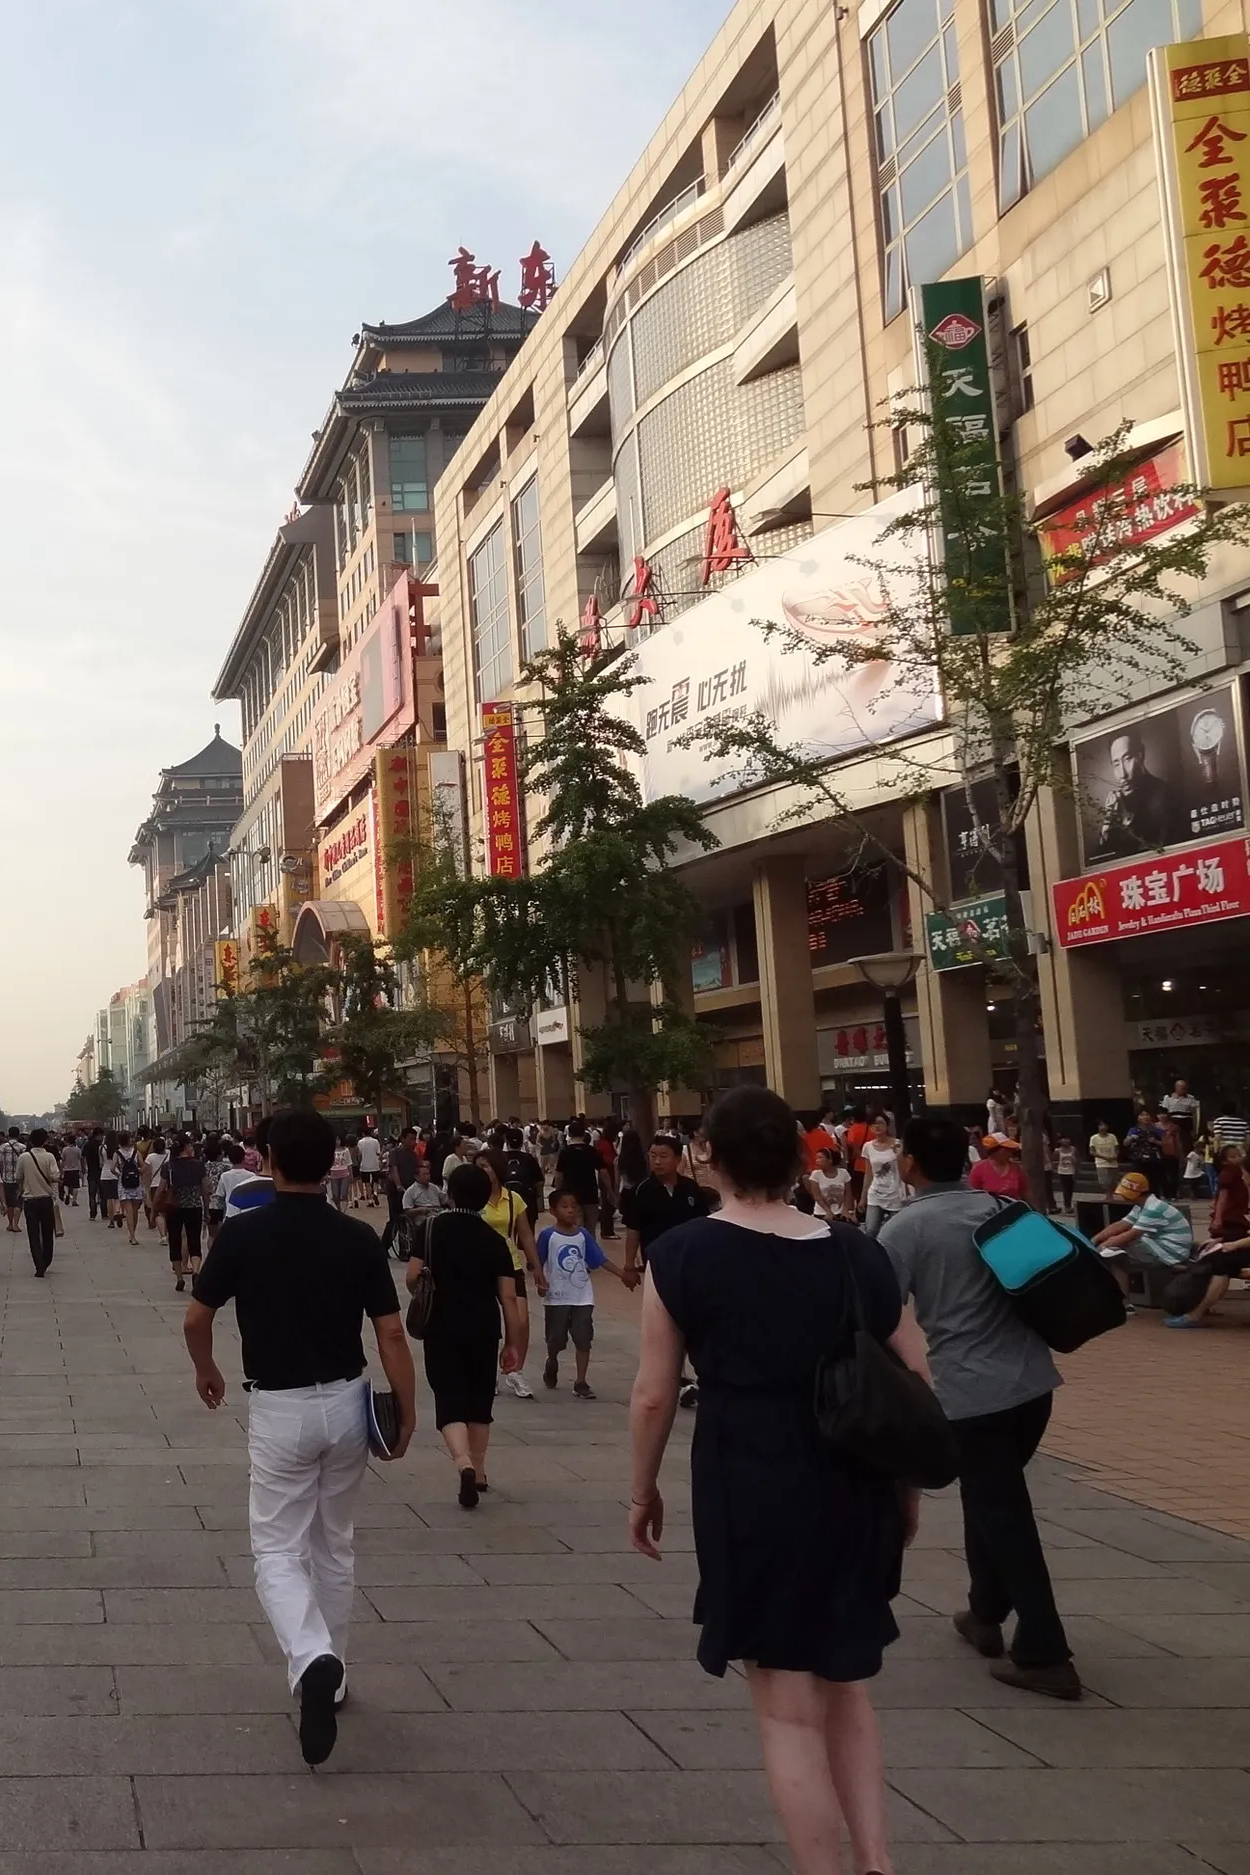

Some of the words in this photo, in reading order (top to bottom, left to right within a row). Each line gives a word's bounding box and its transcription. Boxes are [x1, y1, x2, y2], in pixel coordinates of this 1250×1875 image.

[646, 675, 691, 741] 跑无震
[697, 659, 748, 713] 心无扰
[488, 733, 514, 875] 全聚德烤鸭店
[1119, 856, 1225, 910] 珠宝广场
[931, 926, 962, 951] 天福
